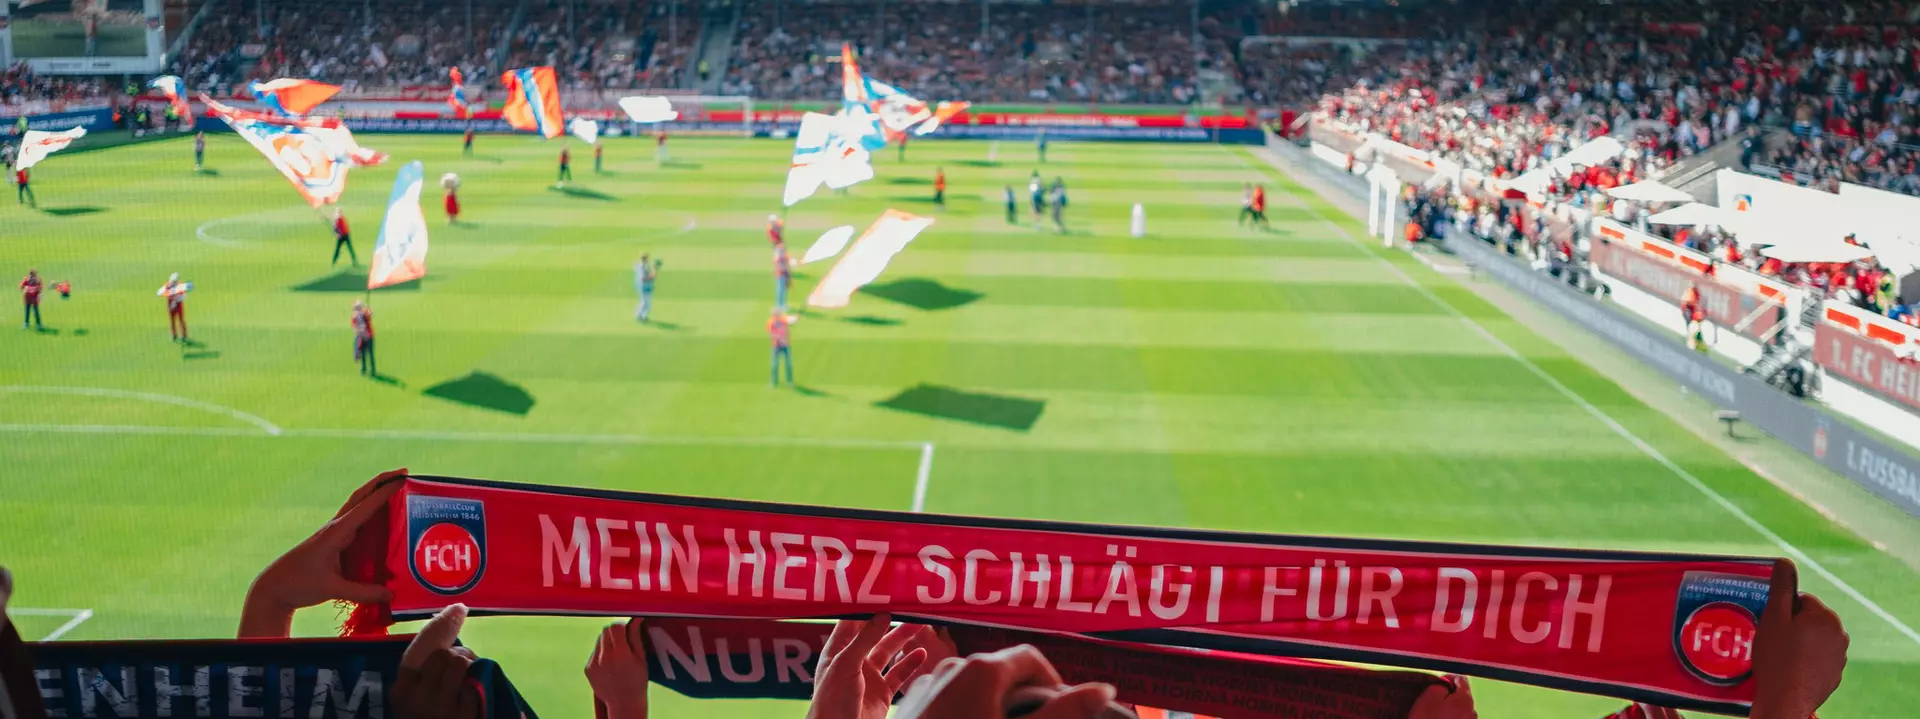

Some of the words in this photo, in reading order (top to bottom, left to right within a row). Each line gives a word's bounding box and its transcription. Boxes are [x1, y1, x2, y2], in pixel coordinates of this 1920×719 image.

[1852, 344, 1876, 385] FC
[461, 511, 480, 521] 1846
[425, 544, 471, 572] FCH
[538, 514, 700, 593] MEIN
[723, 528, 891, 604] HERZ
[1260, 558, 1404, 629] FÜR
[1430, 566, 1612, 652] DICH
[1686, 584, 1747, 599] HEIDENHEIM
[649, 625, 829, 683] NUR
[1693, 621, 1756, 661] FCH
